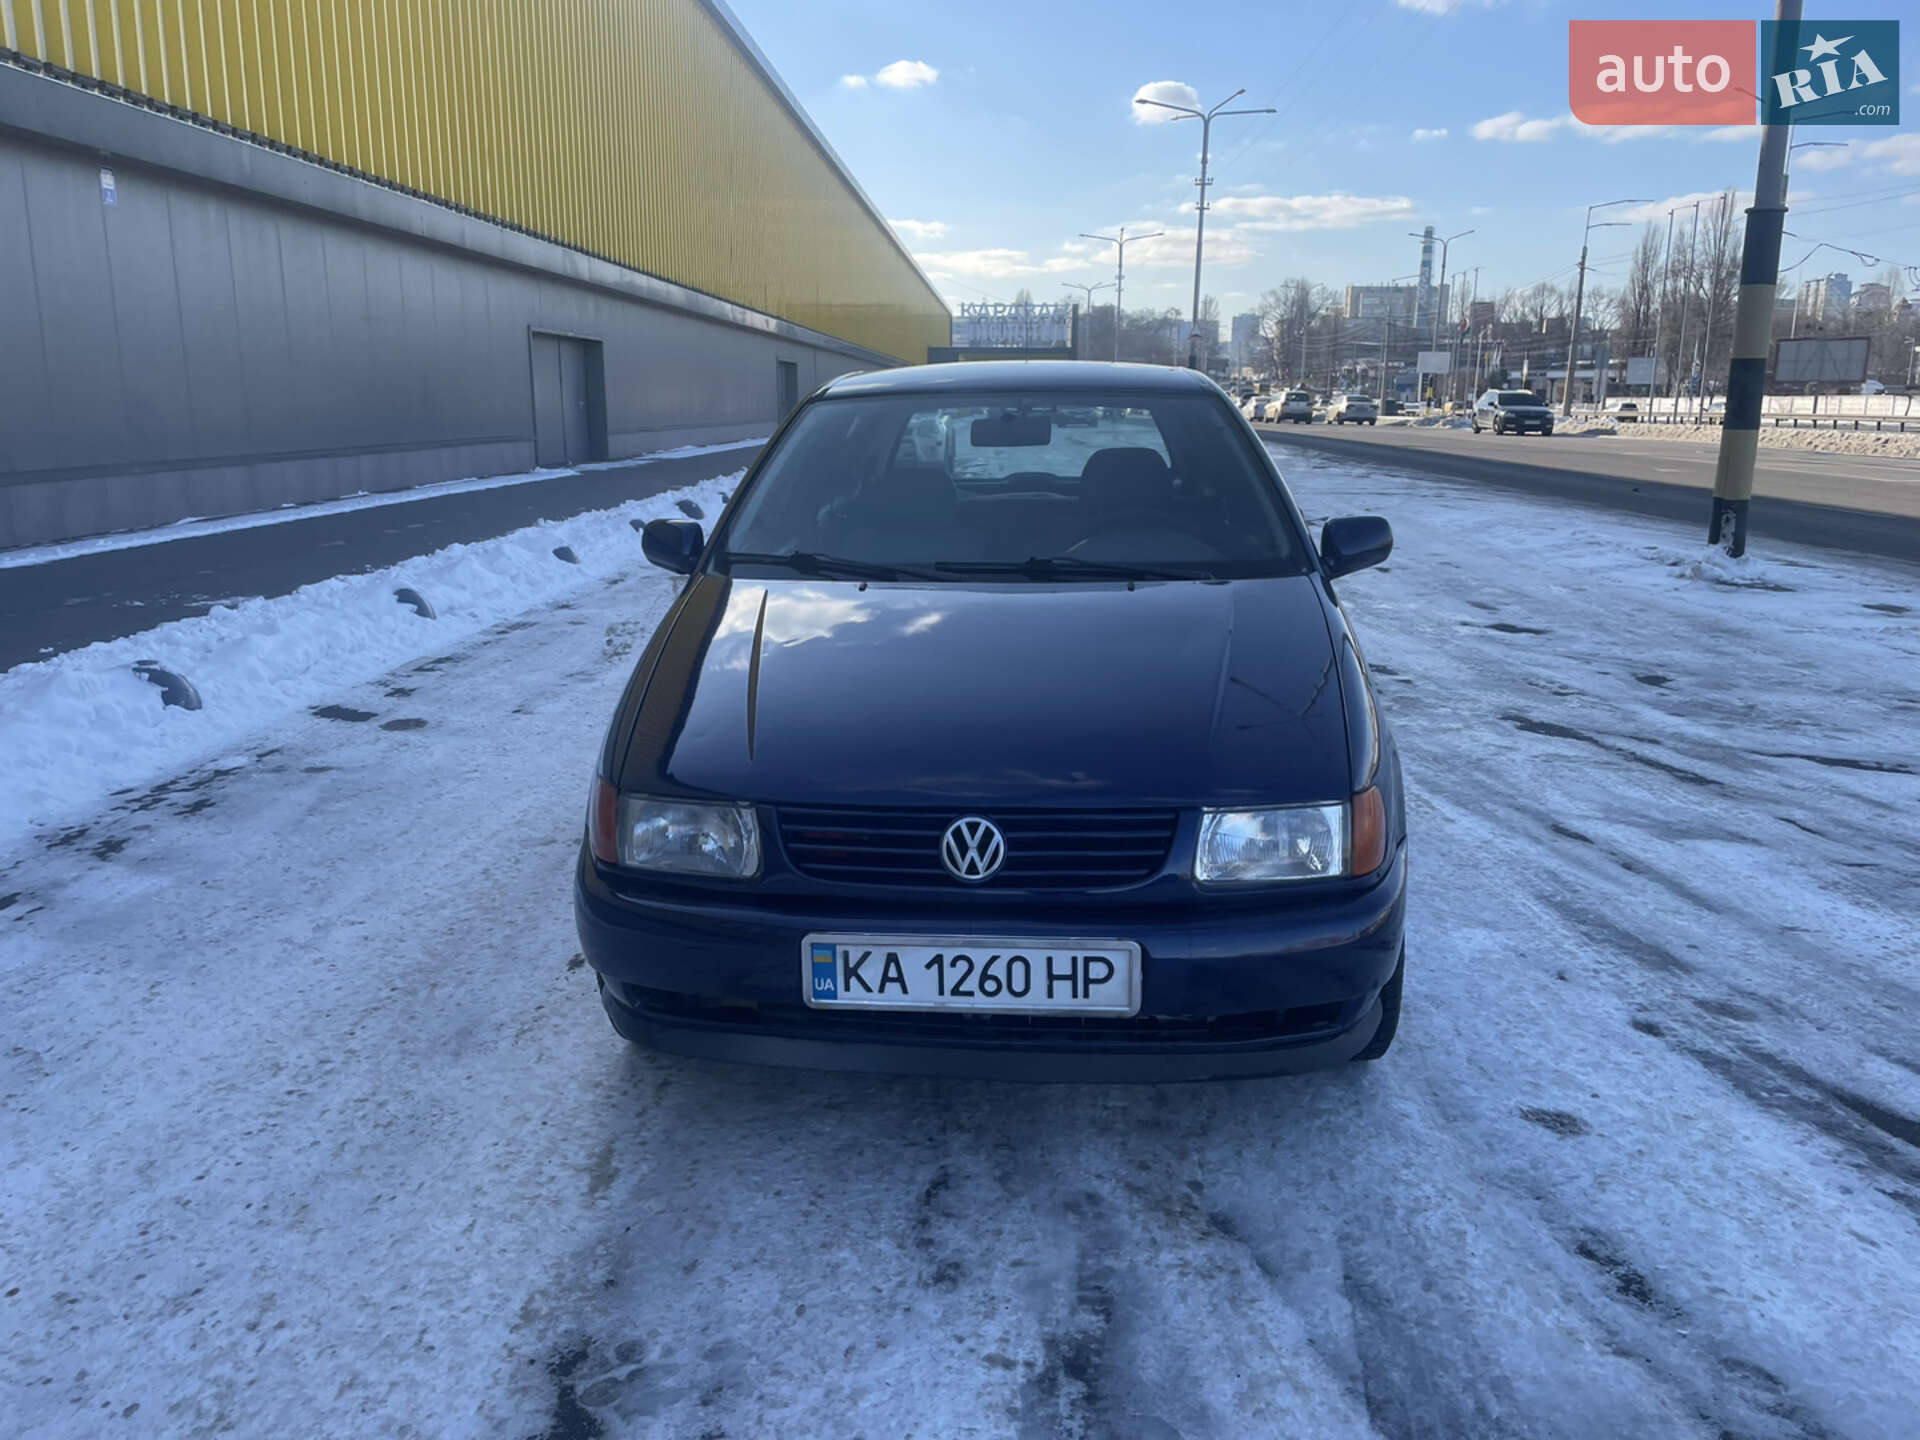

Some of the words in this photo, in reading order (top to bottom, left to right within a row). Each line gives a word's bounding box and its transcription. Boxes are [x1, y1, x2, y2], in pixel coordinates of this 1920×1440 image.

[815, 977, 835, 991] UA
[843, 950, 909, 995] KA
[924, 953, 1031, 998] 1260
[1046, 955, 1115, 999] HP
